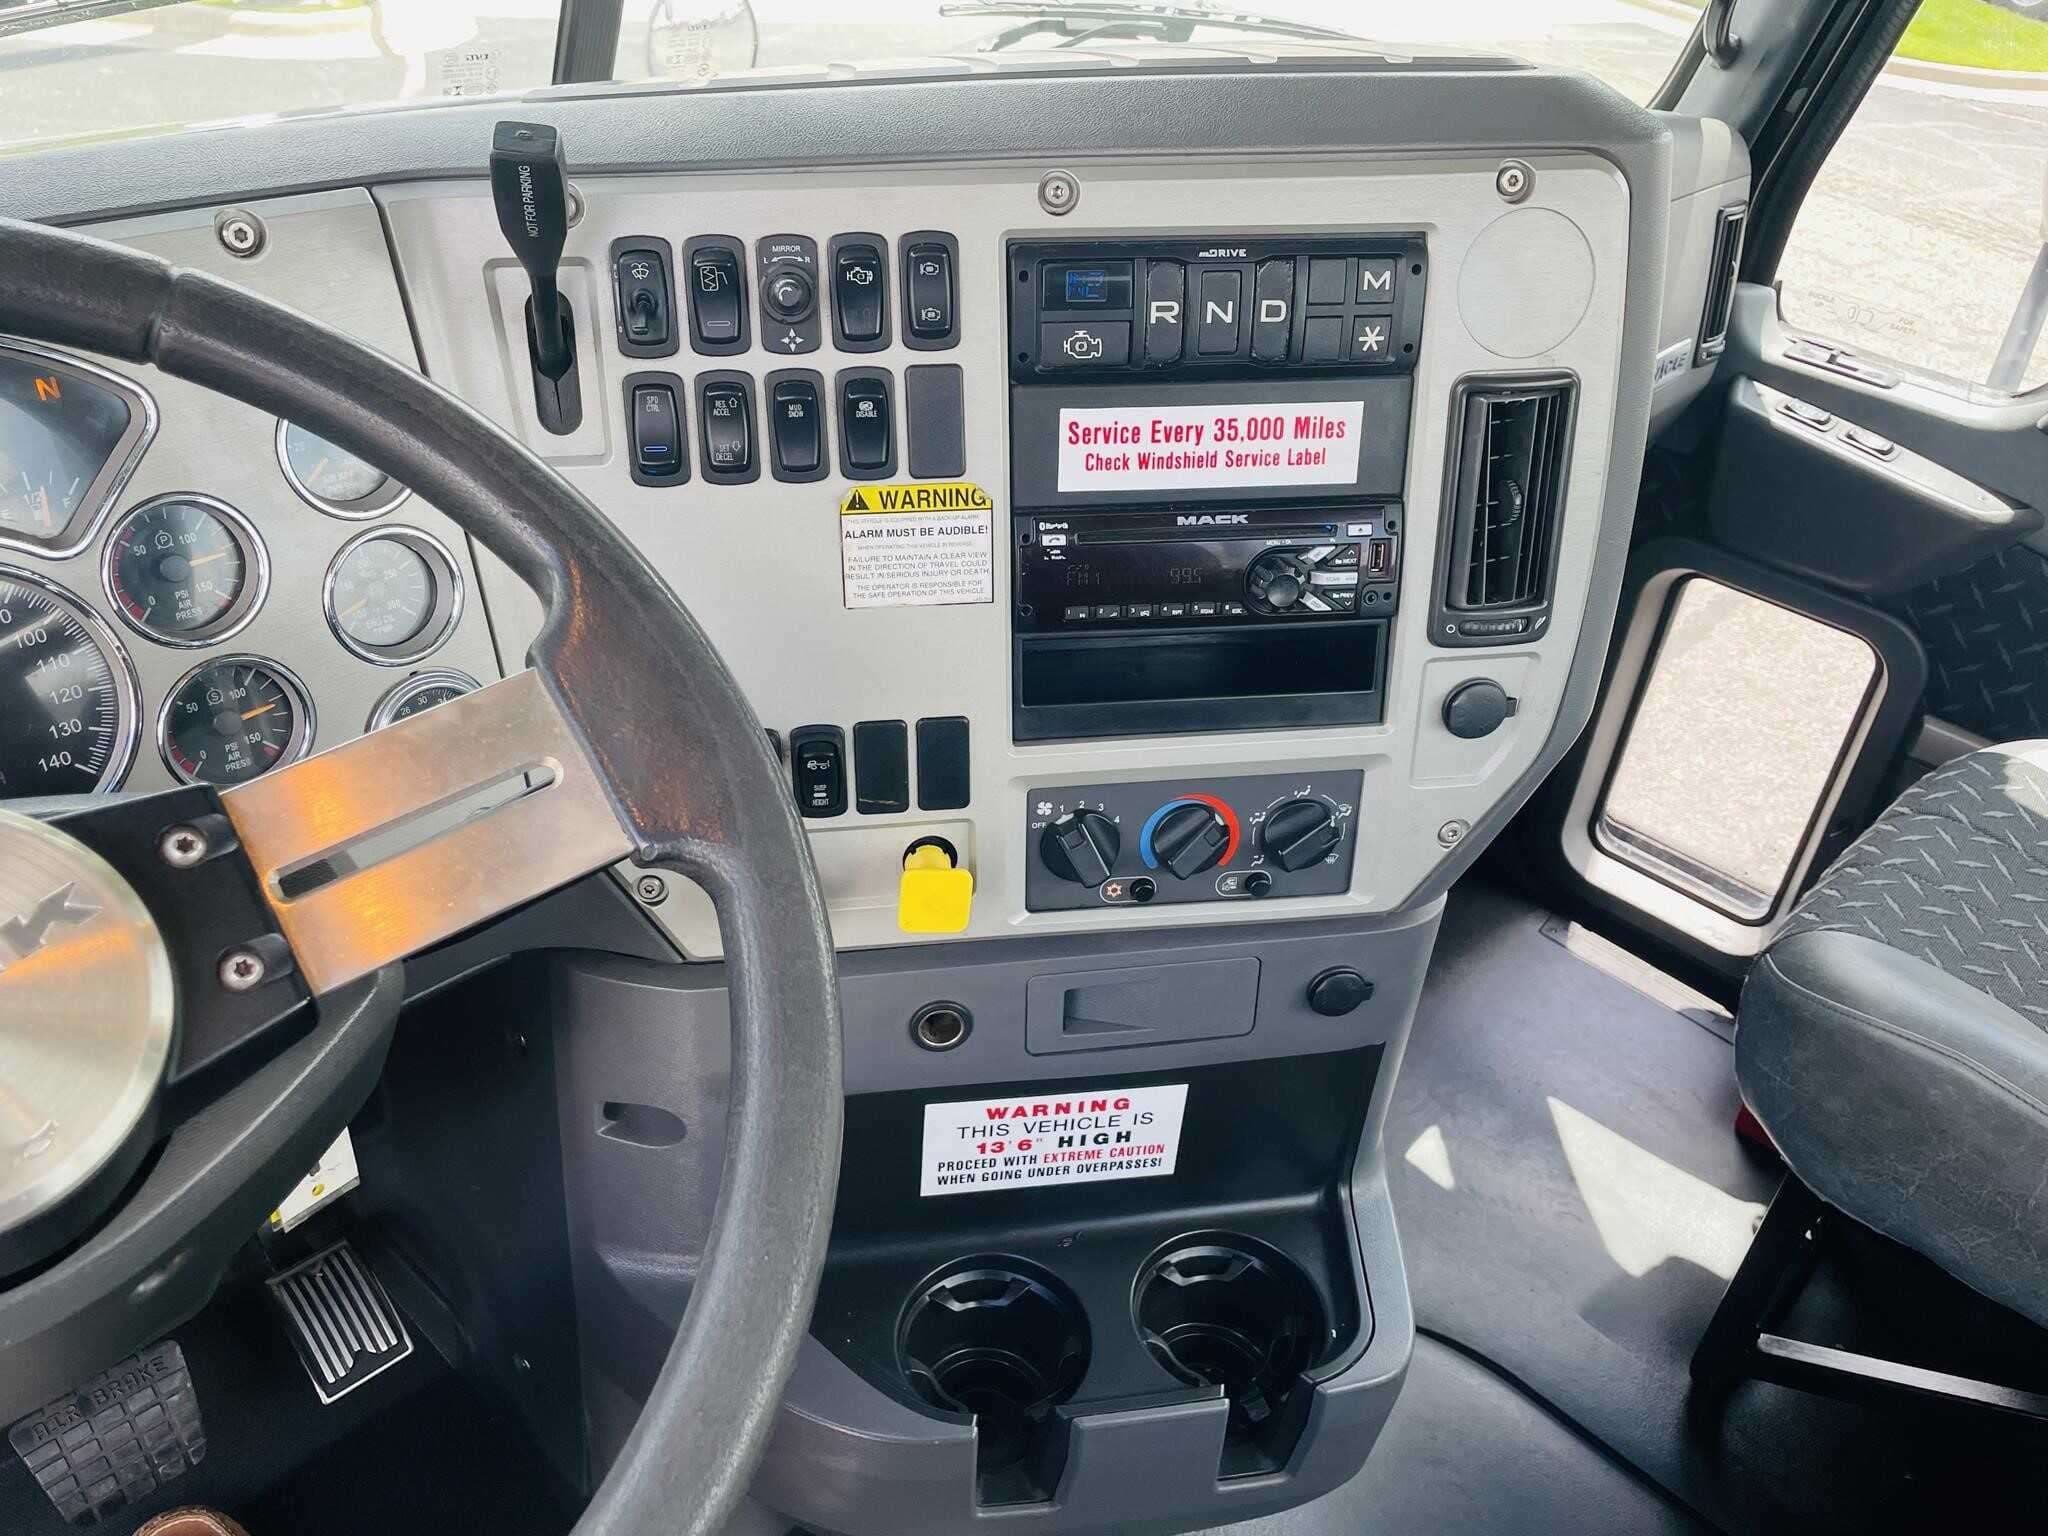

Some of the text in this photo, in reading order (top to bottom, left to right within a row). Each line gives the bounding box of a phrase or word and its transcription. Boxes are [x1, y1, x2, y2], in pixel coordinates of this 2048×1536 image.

[518, 165, 540, 239] NOT FOR PARKING
[772, 245, 801, 253] MIRROR
[763, 256, 769, 264] L
[1363, 270, 1391, 291] M
[1150, 300, 1287, 325] R N D
[34, 376, 61, 401] N
[647, 396, 659, 404] SPD
[646, 403, 660, 412] CTRL
[713, 408, 731, 416] ACCEL
[788, 410, 804, 418] SNOW
[856, 410, 878, 418] DISABLE
[1068, 416, 1346, 446] Service Every 35,000 Miles
[716, 452, 734, 460] DECEL
[1085, 448, 1326, 471] Check Windshield Service Label
[879, 488, 987, 510] WARNING
[1177, 514, 1249, 526] MACK
[845, 525, 988, 539] ALARM MUST BE AUDIBLE!
[179, 532, 197, 545] 100
[133, 545, 147, 556] 50
[895, 553, 931, 561] MAINTAIN
[874, 562, 915, 571] DIRECTION
[846, 572, 875, 580] RESULT
[922, 569, 949, 577] INJURY
[195, 581, 213, 593] 150
[872, 583, 910, 591] OPERATOR
[920, 580, 967, 588] RESPONSIBLE
[174, 590, 190, 600] PSI
[887, 590, 927, 598] OPERATION
[956, 587, 984, 595] VEHICLE
[148, 596, 156, 605] 0
[178, 599, 192, 609] AIR
[175, 607, 203, 622] PRESS
[14, 628, 48, 649] 100
[36, 653, 71, 673] 110
[50, 685, 83, 705] 120
[230, 687, 247, 700] 100
[417, 696, 428, 705] 30
[185, 702, 199, 713] 50
[400, 706, 411, 715] 26
[49, 719, 82, 740] 130
[244, 732, 262, 745] 150
[225, 741, 239, 752] PSI
[200, 750, 207, 760] 0
[228, 751, 242, 761] AIR
[38, 751, 72, 772] 140
[225, 757, 251, 773] PRESS
[1060, 804, 1065, 812] 1
[1079, 800, 1085, 808] 2
[1098, 803, 1104, 811] 3
[987, 1098, 1130, 1120] WARNING
[957, 1112, 1153, 1139] THIS VEHICLE IS
[1058, 1131, 1131, 1148] HIGH
[938, 1144, 1165, 1172] PROCEED WITH EXTREME CAUTION
[937, 1157, 1162, 1185] WHEN GOING UNDER OVERPASSES!
[92, 1355, 169, 1405] BRAKE
